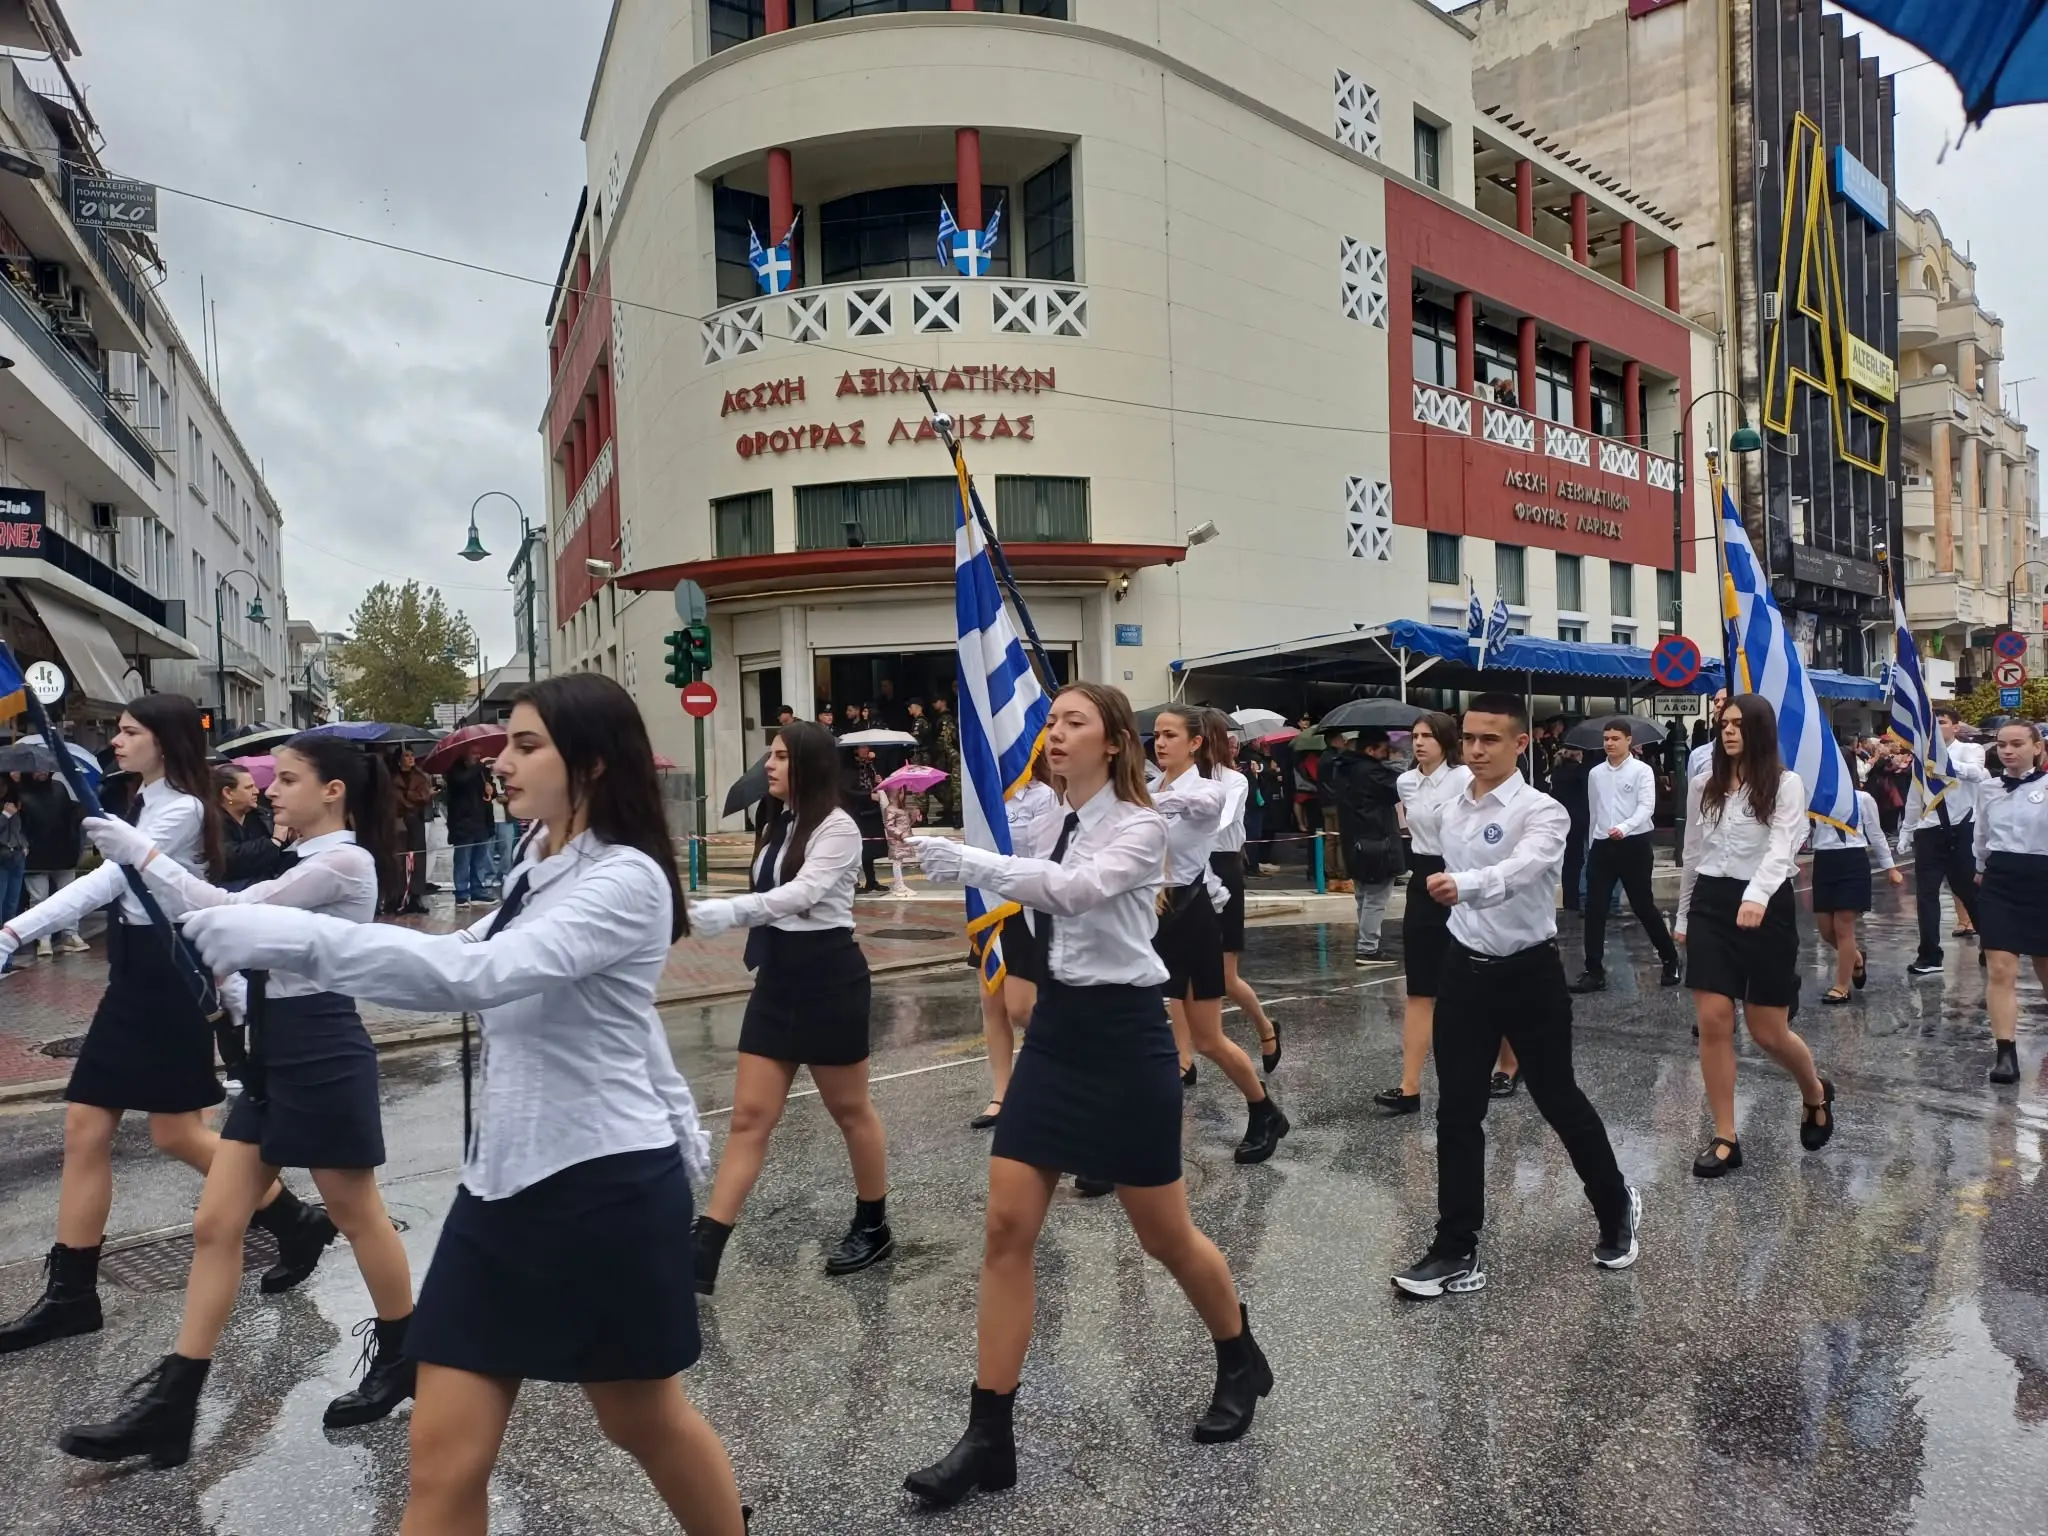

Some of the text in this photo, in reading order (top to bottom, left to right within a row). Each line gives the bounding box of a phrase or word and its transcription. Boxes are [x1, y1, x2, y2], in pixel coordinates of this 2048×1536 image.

[88, 181, 142, 192] ΔΙΑΧΕΙΡΙΣΗ
[1853, 344, 1891, 382] ALTERLIFE
[720, 364, 1055, 418] ΛΕΣΧΗ ΑΞΙΩΜΑΤΙΚΩΝ
[736, 419, 866, 459] ΦΡΟΥΡΑΣ
[1505, 468, 1548, 493] ΛΕΣΧΗ
[1515, 502, 1623, 540] ΦΡΟΥΡΑΣ ΛΑΡΙΣΑΣ
